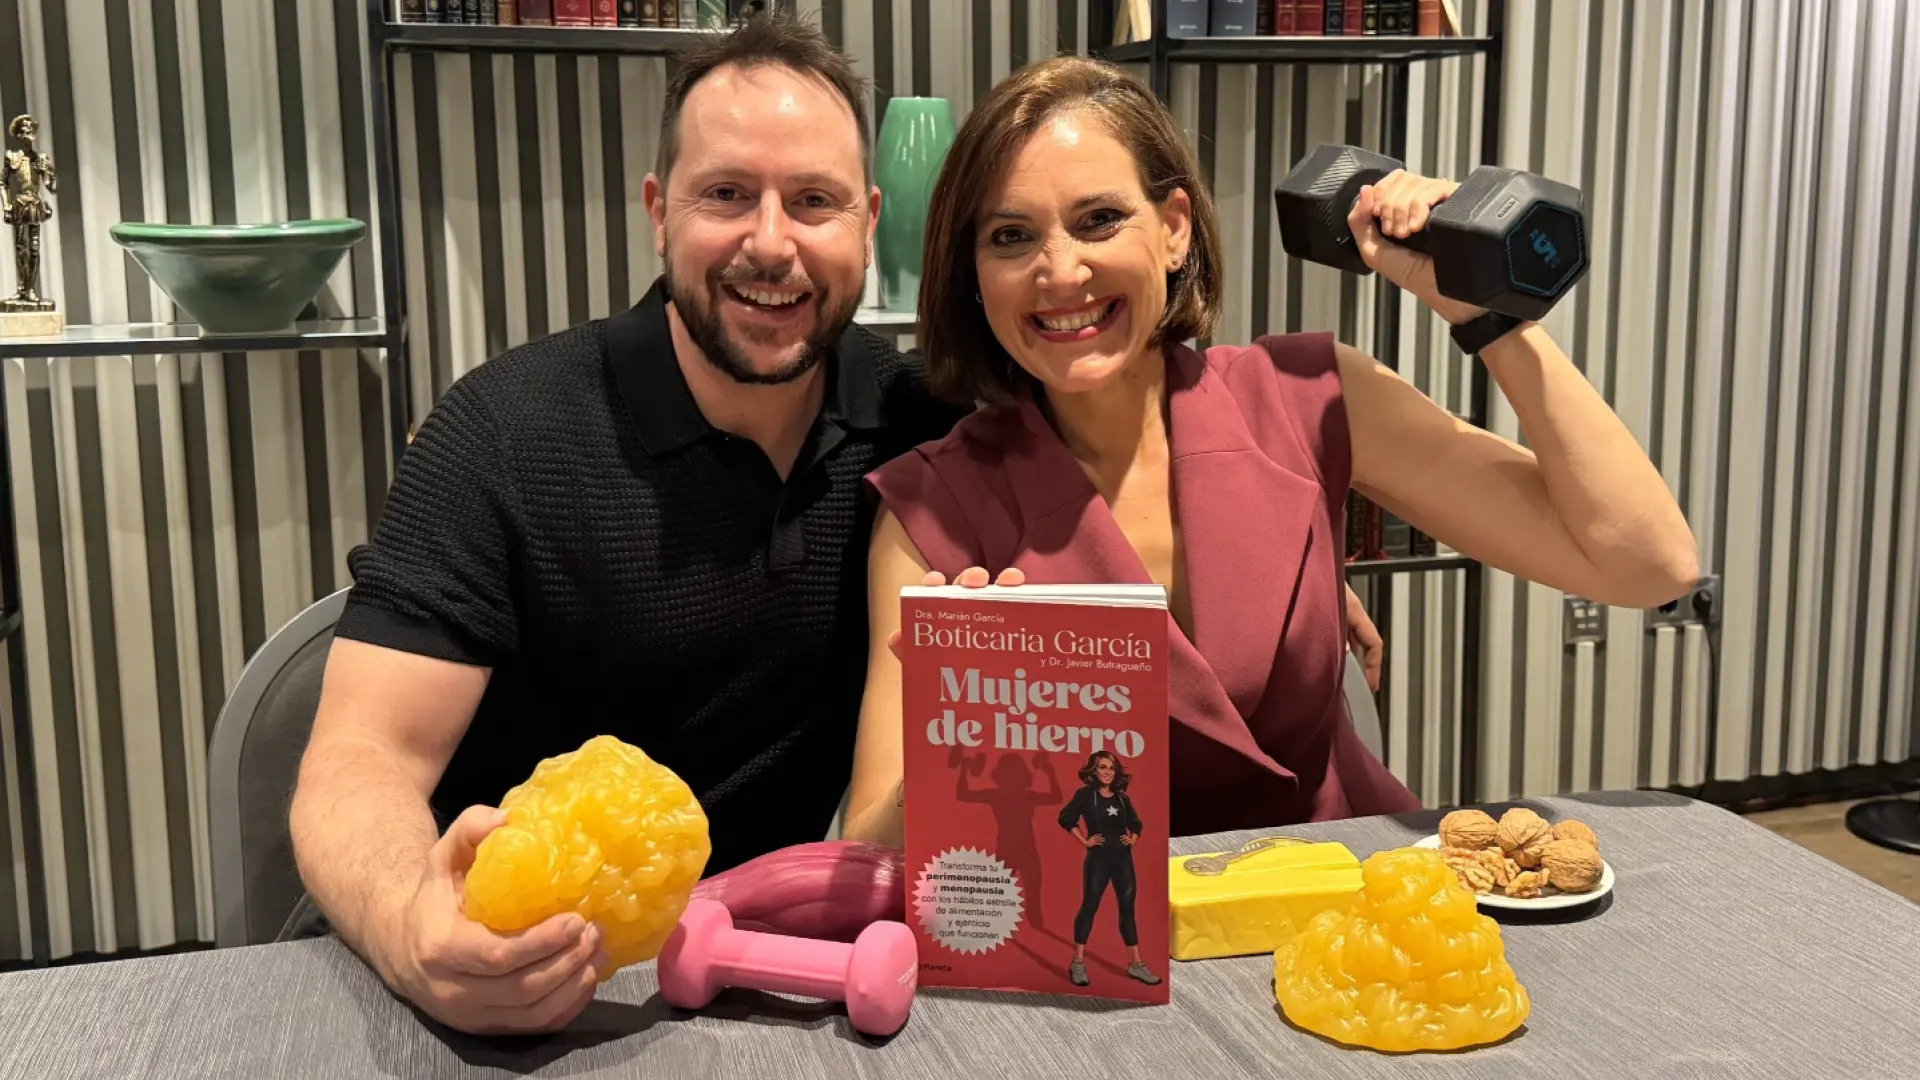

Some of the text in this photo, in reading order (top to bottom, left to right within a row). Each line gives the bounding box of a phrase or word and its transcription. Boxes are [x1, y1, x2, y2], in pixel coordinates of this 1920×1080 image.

[915, 608, 1005, 623] Dra. Marián García
[913, 622, 1151, 660] Boticaria García
[1040, 657, 1152, 673] y Dr. Javier Butragueño
[939, 666, 1133, 715] Mujeres
[926, 709, 1146, 758] de hierro
[940, 861, 987, 872] Transforma
[926, 872, 1011, 884] perimenopausia
[933, 885, 1004, 895] y menopausia
[940, 895, 952, 904] los
[954, 896, 984, 905] hábitos
[986, 898, 1017, 908] estrella
[936, 906, 1002, 917] de alimentación
[947, 919, 991, 928] y ejercicio
[939, 929, 1000, 940] que funcionan
